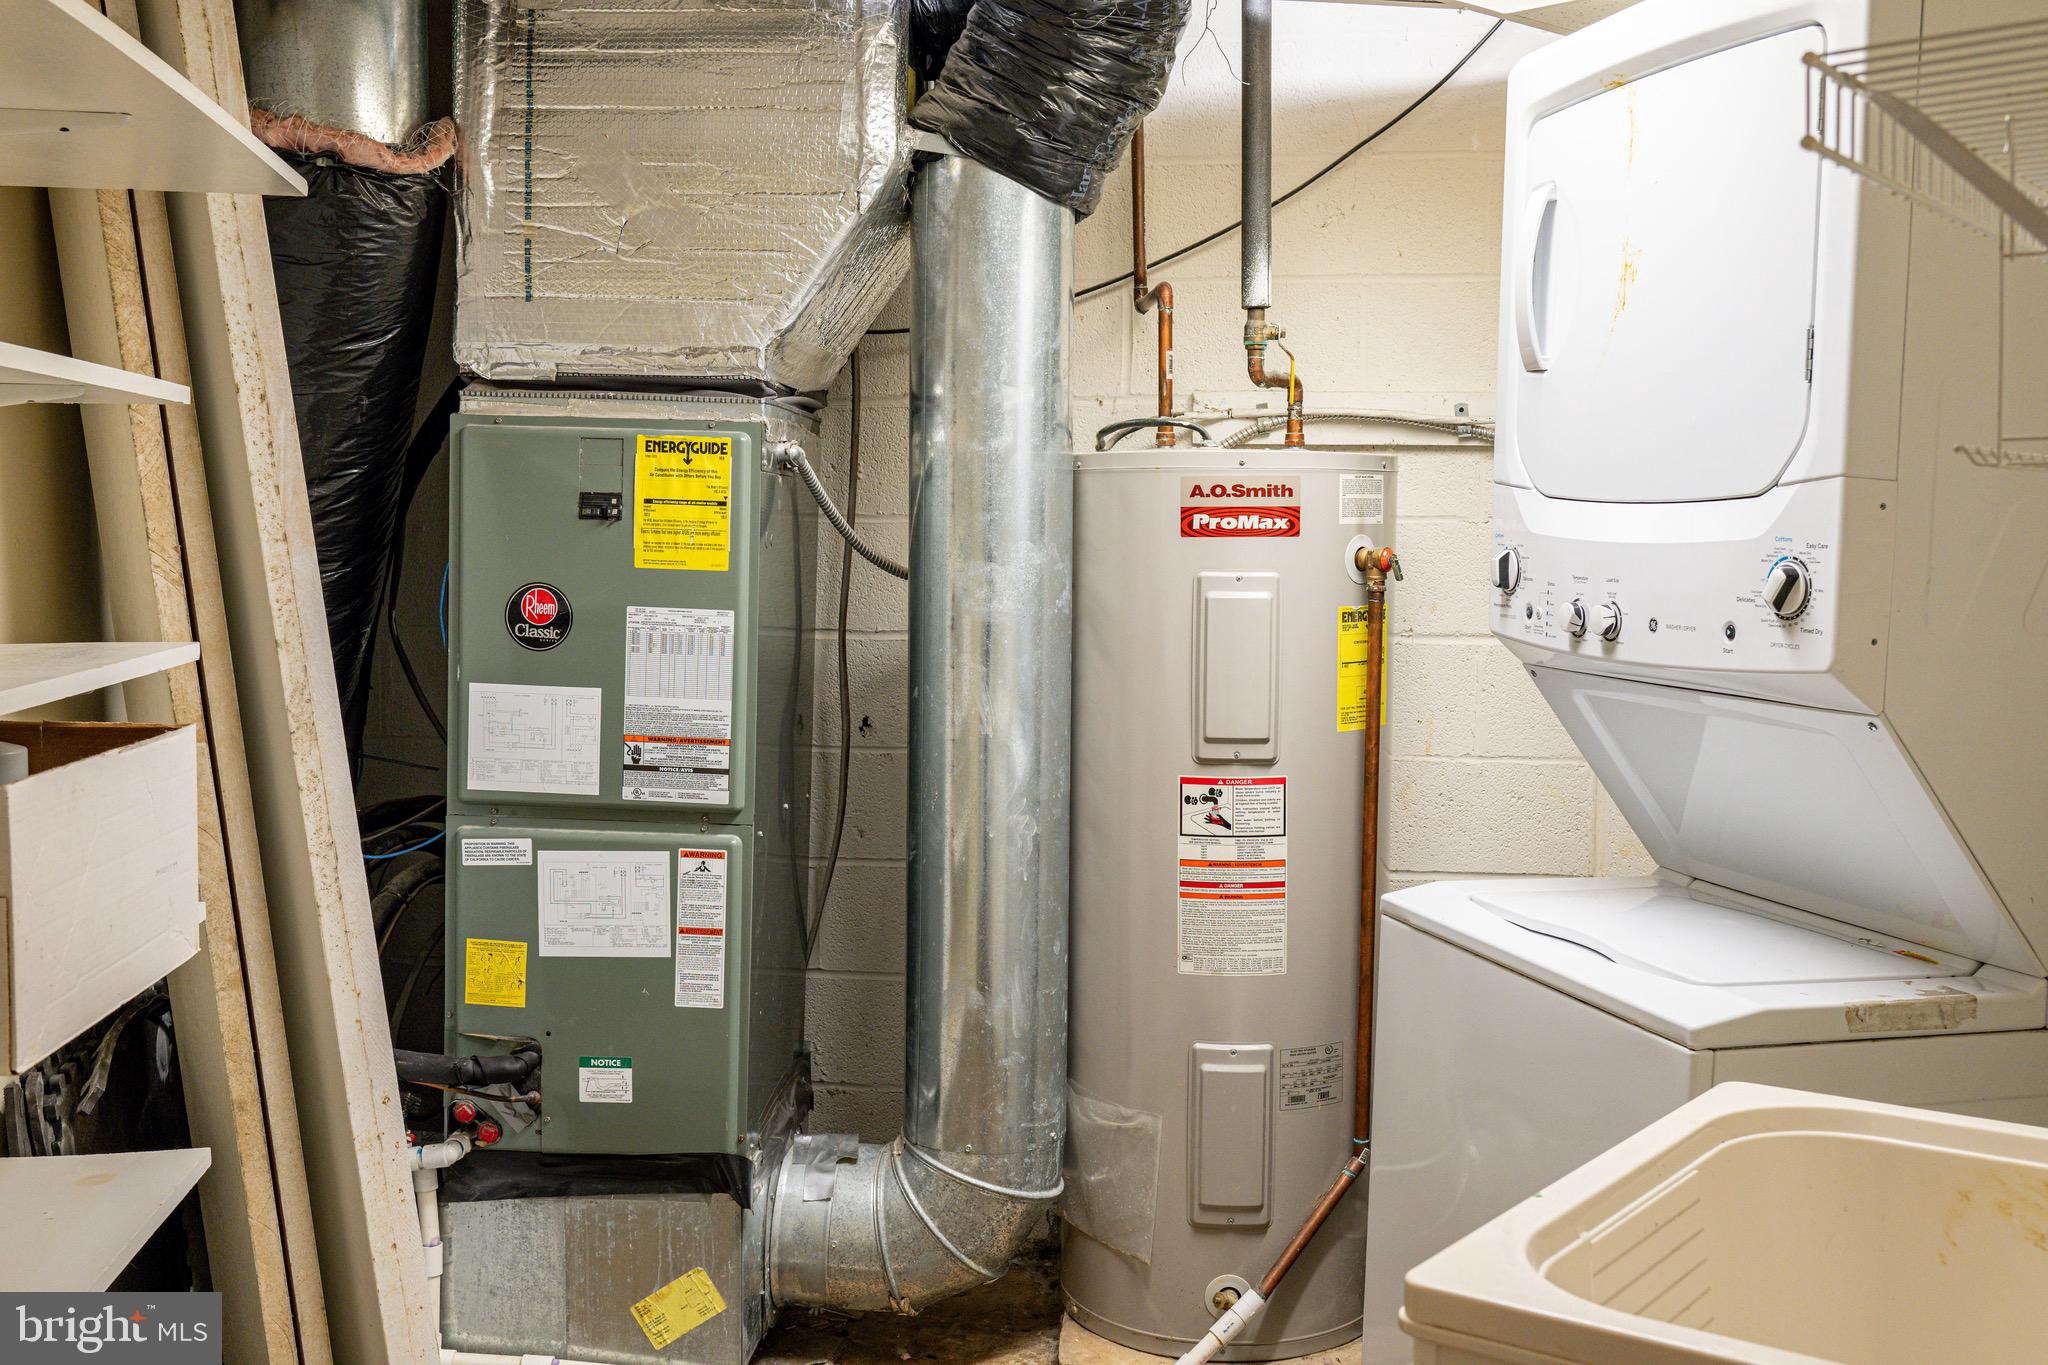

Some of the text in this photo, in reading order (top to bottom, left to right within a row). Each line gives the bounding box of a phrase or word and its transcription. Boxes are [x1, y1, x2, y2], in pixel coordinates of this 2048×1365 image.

[645, 440, 728, 456] ENERGYGUIDE
[1189, 484, 1294, 497] A.O.Smith
[1192, 514, 1289, 529] ProMax
[526, 590, 555, 619] Rheem
[515, 624, 560, 639] Classic
[1815, 628, 1823, 636] Dry
[689, 851, 722, 859] WARNING
